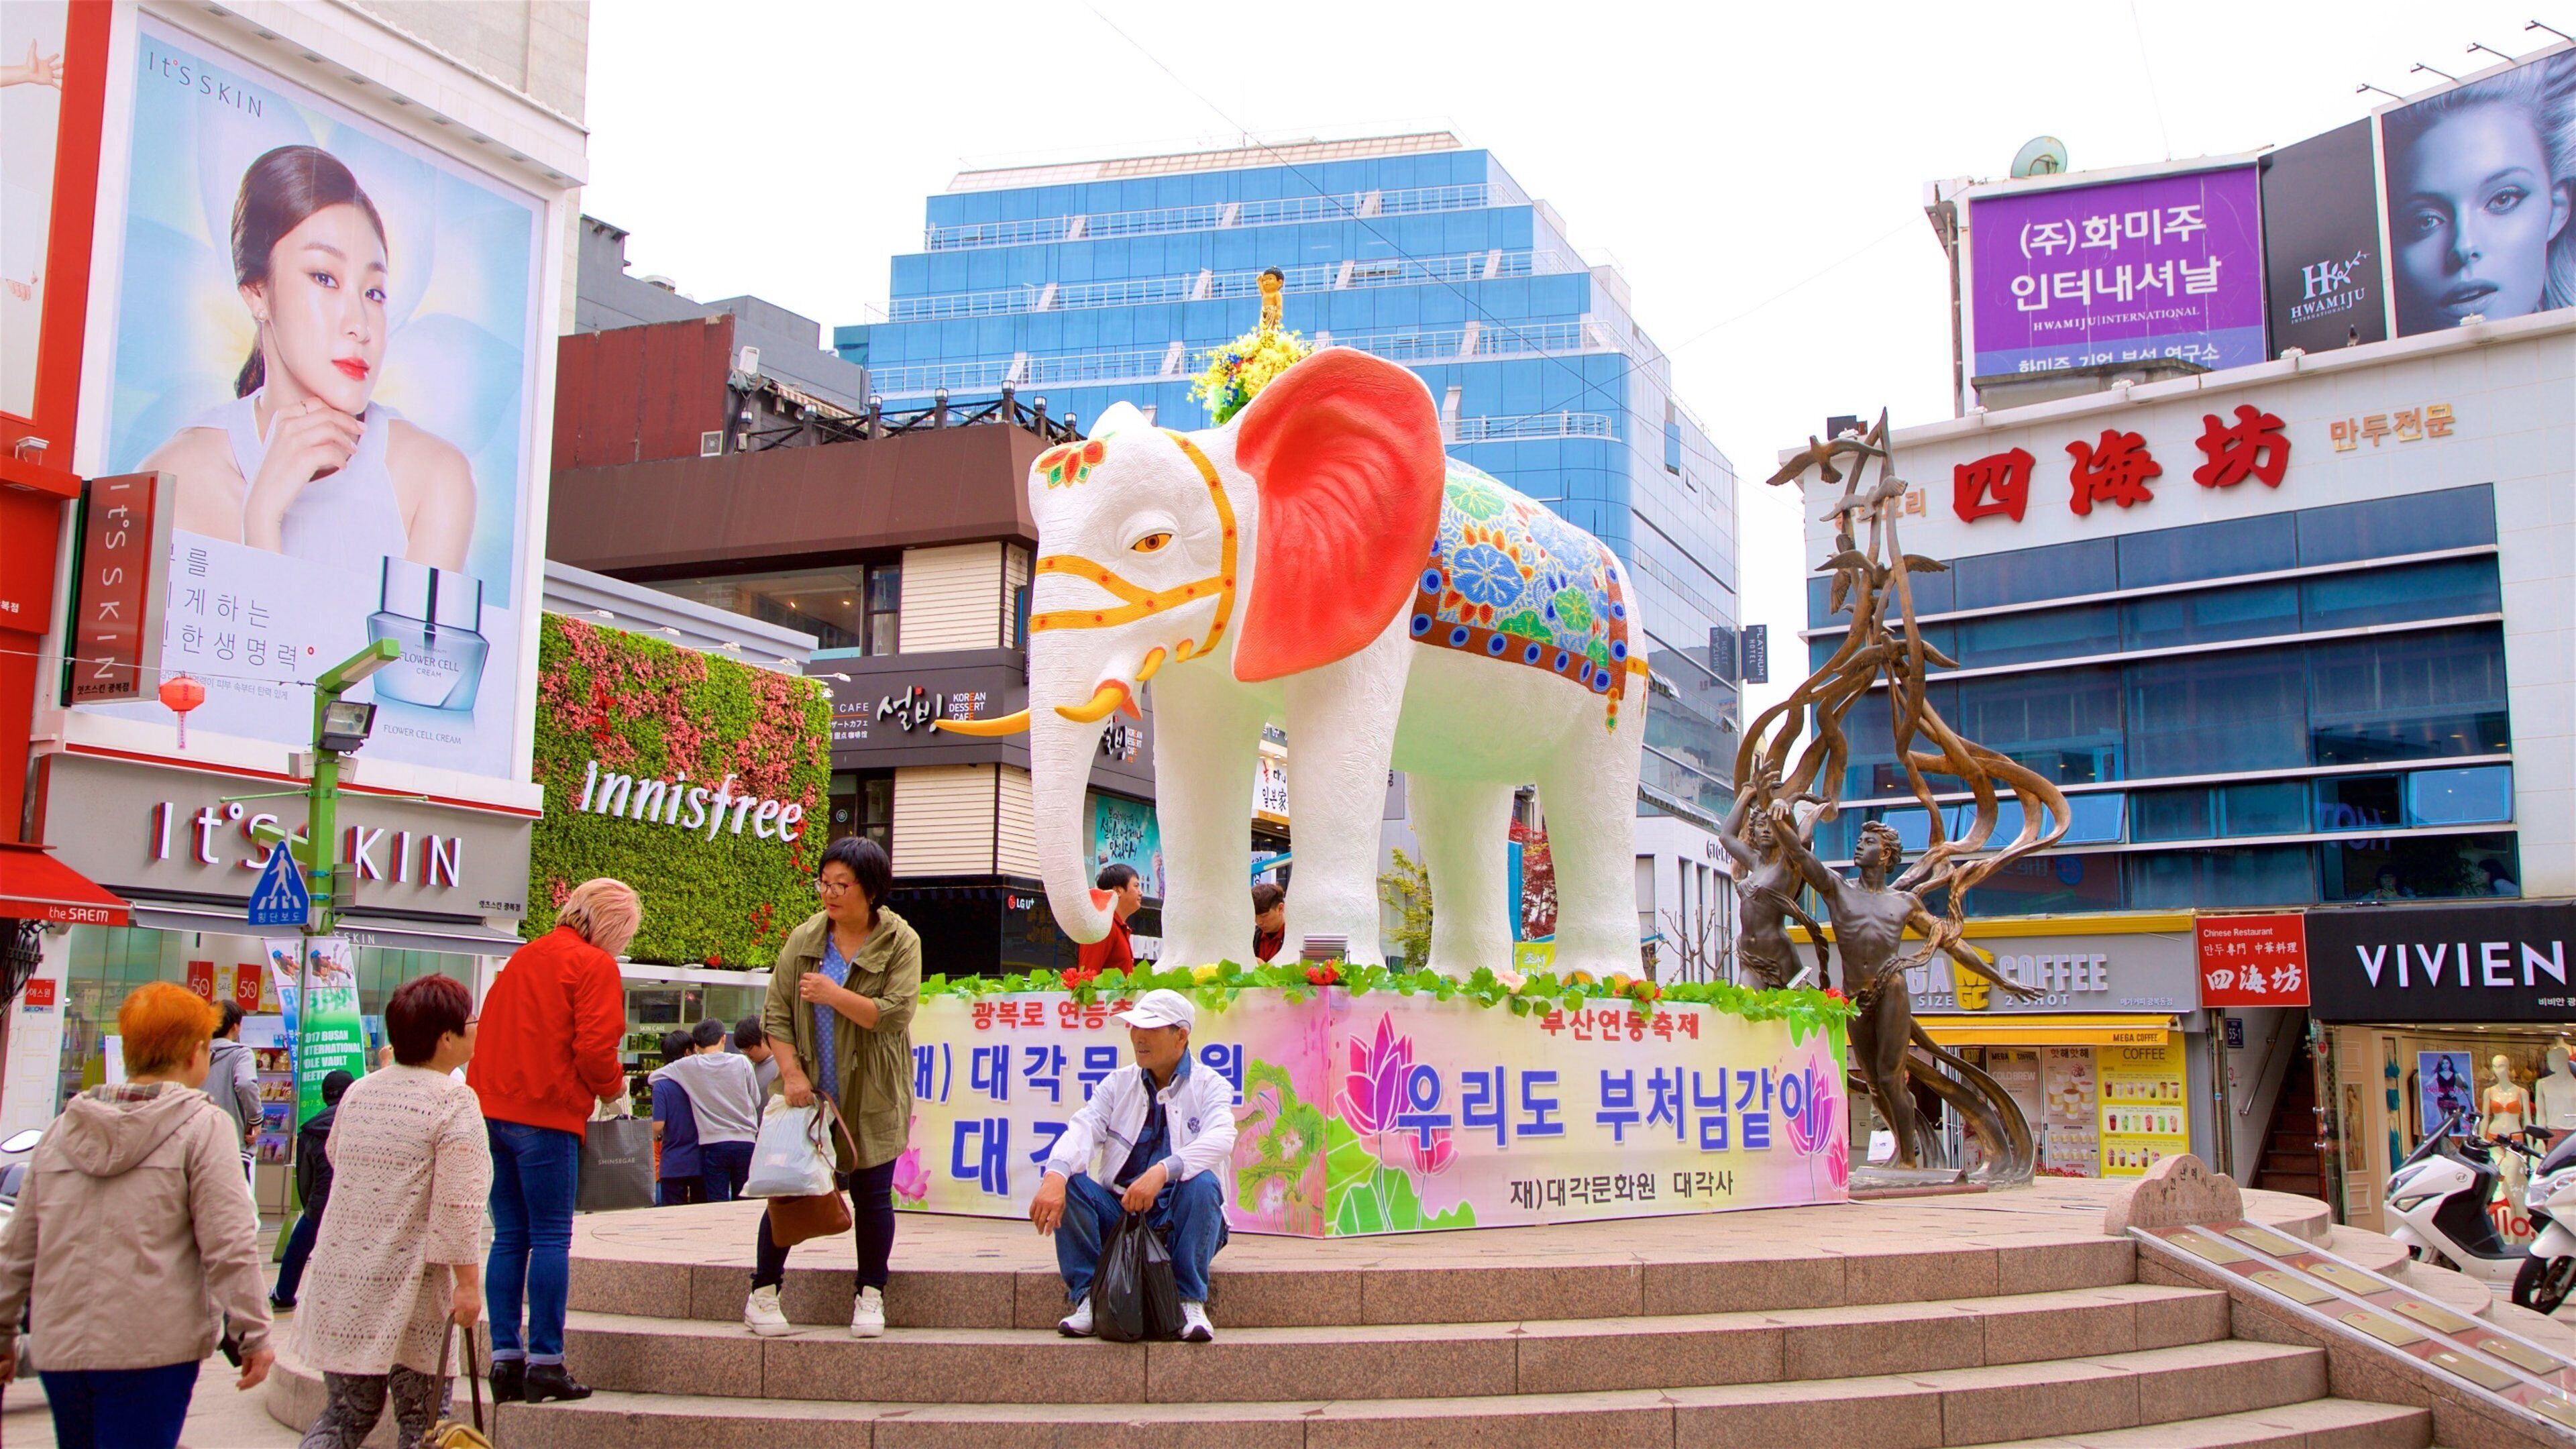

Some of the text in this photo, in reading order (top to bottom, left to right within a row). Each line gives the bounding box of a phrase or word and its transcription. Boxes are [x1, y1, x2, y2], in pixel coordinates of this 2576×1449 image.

[2010, 256, 2222, 311] 인터내셔날
[2290, 287, 2365, 319] HWAMIJU
[2101, 307, 2200, 325] INTERNATIONAL
[2291, 306, 2345, 325] INTERNATIONAL
[2330, 404, 2455, 451] 만두전문
[1953, 405, 2292, 523] 四海坊
[1756, 627, 1764, 676] PLATINUM
[416, 667, 442, 678] CREAM
[437, 659, 460, 672] CELL
[953, 692, 986, 704] KOREAN
[839, 702, 869, 713] CAFE
[877, 685, 943, 733] 설빙
[949, 702, 984, 712] DESSERT
[953, 712, 974, 721] CAFE
[829, 720, 868, 729] ザートカフェ
[384, 724, 462, 745] FLOWER CELL CREAM
[578, 760, 802, 843] innisfree
[49, 907, 109, 922] the SAEM
[2203, 927, 2273, 938] Chinese Restaurant
[2255, 941, 2298, 955] 中華料理
[2355, 941, 2567, 987] VIVIEN
[1998, 954, 2108, 991] COFFEE
[2206, 963, 2302, 994] 四海坊
[1919, 994, 2070, 1007] SIZE 2 SHOT
[2538, 998, 2565, 1006] 비비안
[971, 1002, 1045, 1030] 광복로
[321, 1030, 349, 1041] BUSAN
[2113, 1033, 2157, 1042] MEGA COFFEE
[2123, 1048, 2165, 1060] COFFEE
[304, 1055, 347, 1069] OLE VAULT
[1397, 1064, 1816, 1152] 우리도 부처님같이
[598, 1157, 636, 1165] SHINSEGAE
[1673, 1169, 1733, 1199] 대각사
